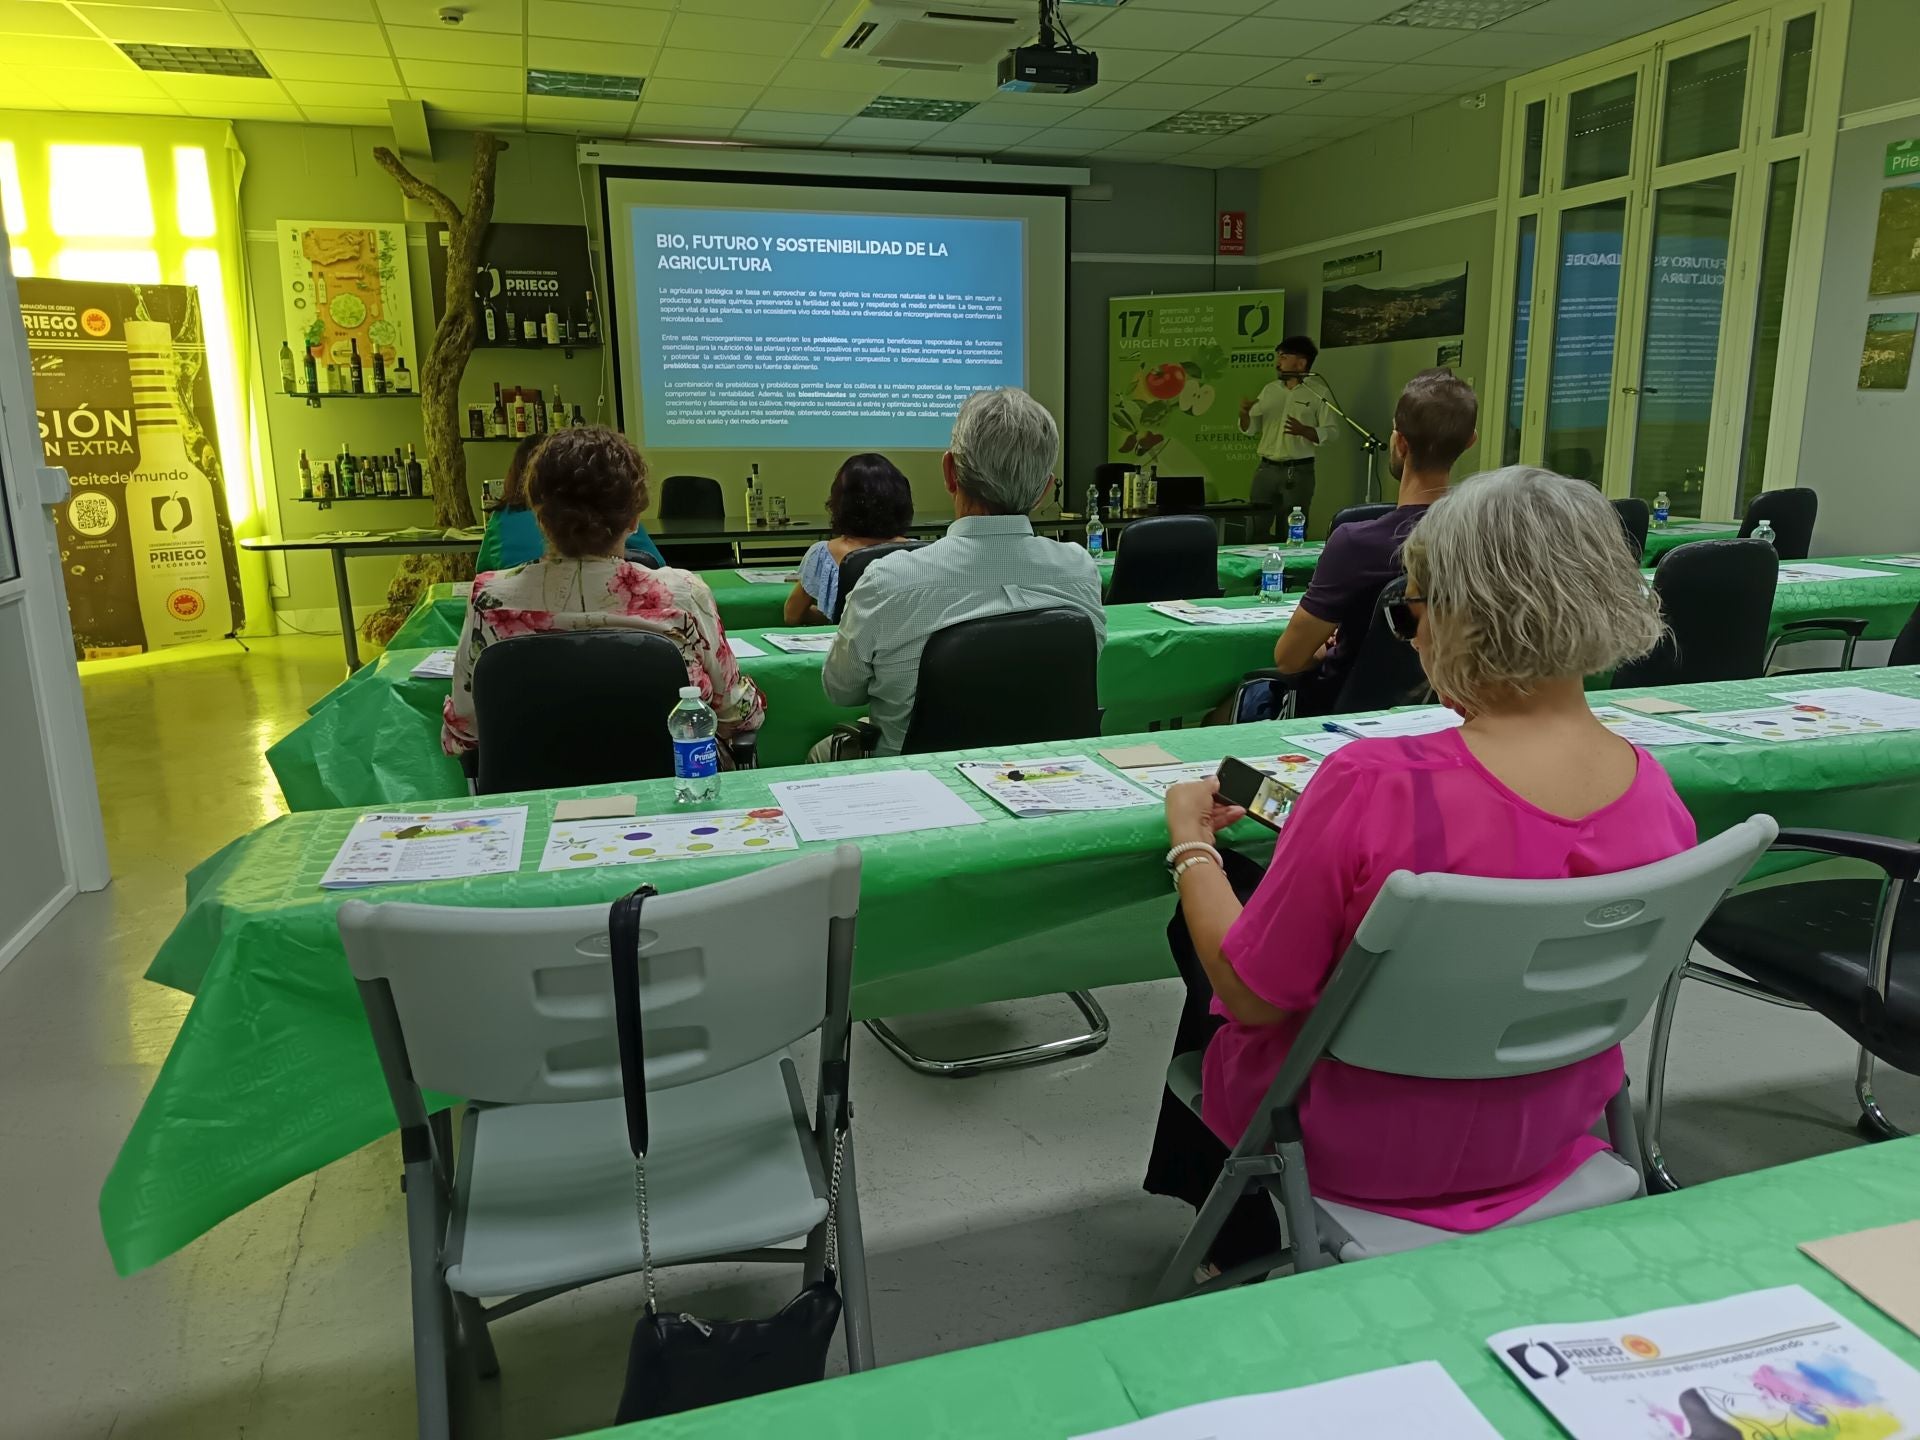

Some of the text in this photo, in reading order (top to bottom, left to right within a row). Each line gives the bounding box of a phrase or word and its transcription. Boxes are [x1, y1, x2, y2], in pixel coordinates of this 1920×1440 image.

[1892, 154, 1920, 170] Prie
[656, 234, 948, 256] BIO, FUTURO Y SOSTENIBILIDAD DE LA
[658, 255, 772, 272] AGRICULTURA
[506, 280, 558, 291] PRIEGO
[669, 287, 702, 295] agricultura
[704, 288, 733, 296] biológica
[772, 289, 805, 297] aprovechar
[659, 296, 691, 304] productos
[755, 298, 793, 306] preservando
[902, 311, 951, 319] microorganismos
[1160, 316, 1196, 324] CALIDAD
[22, 315, 78, 330] RIEGO
[29, 330, 79, 338] CÓRDOBA
[700, 334, 752, 342] microorganismos
[1120, 337, 1218, 349] VIRGEN EXTRA
[1231, 353, 1274, 363] PRIEGO
[67, 440, 134, 456] EXTRA
[69, 469, 189, 486] ceitedelmundo
[150, 550, 206, 563] PRIEGO
[1562, 1346, 1623, 1360] PRIEGO
